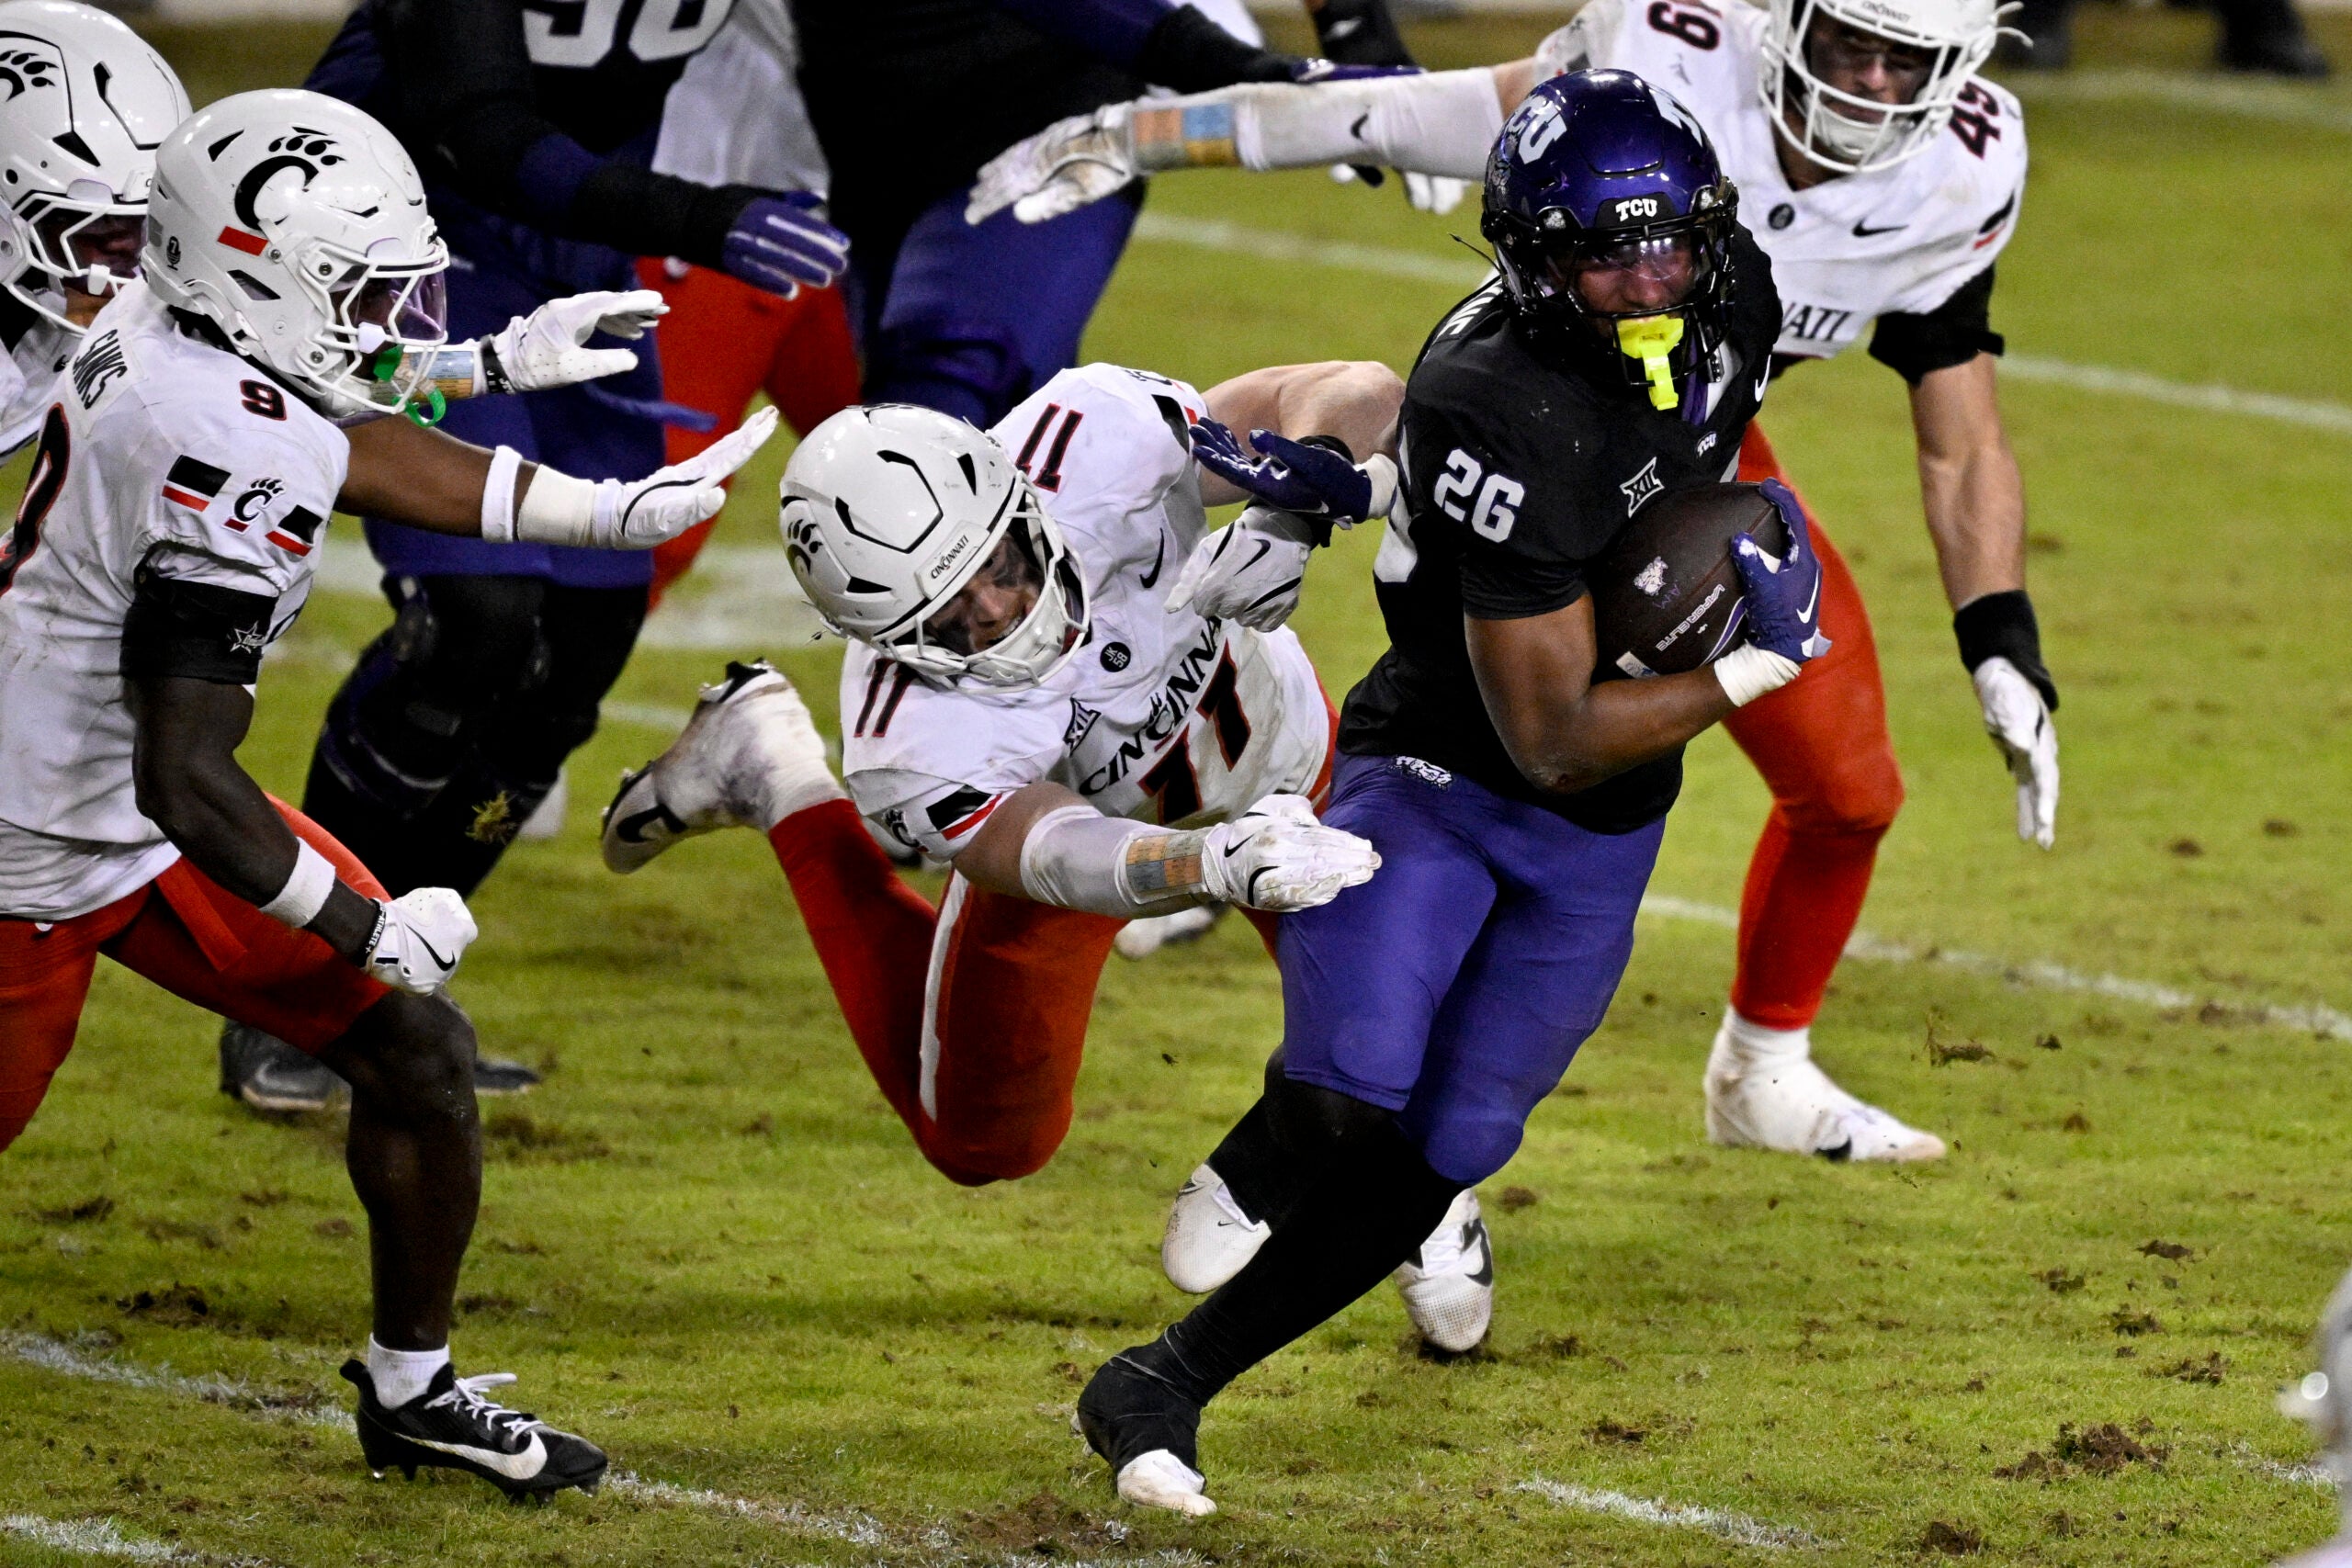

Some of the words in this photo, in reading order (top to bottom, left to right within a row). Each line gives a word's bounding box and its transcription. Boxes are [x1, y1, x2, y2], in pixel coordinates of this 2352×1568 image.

[1948, 80, 2000, 160] 49
[1615, 197, 1658, 222] TCU
[239, 378, 288, 421] 9
[1014, 402, 1084, 493] 11
[1697, 432, 1717, 457] TCU
[1433, 448, 1525, 544] 26
[930, 535, 970, 580] CINCINNATI
[1104, 646, 1119, 661] JK
[1655, 620, 1690, 652] ELITE
[1112, 651, 1128, 669] 58
[1136, 637, 1252, 825] 11
